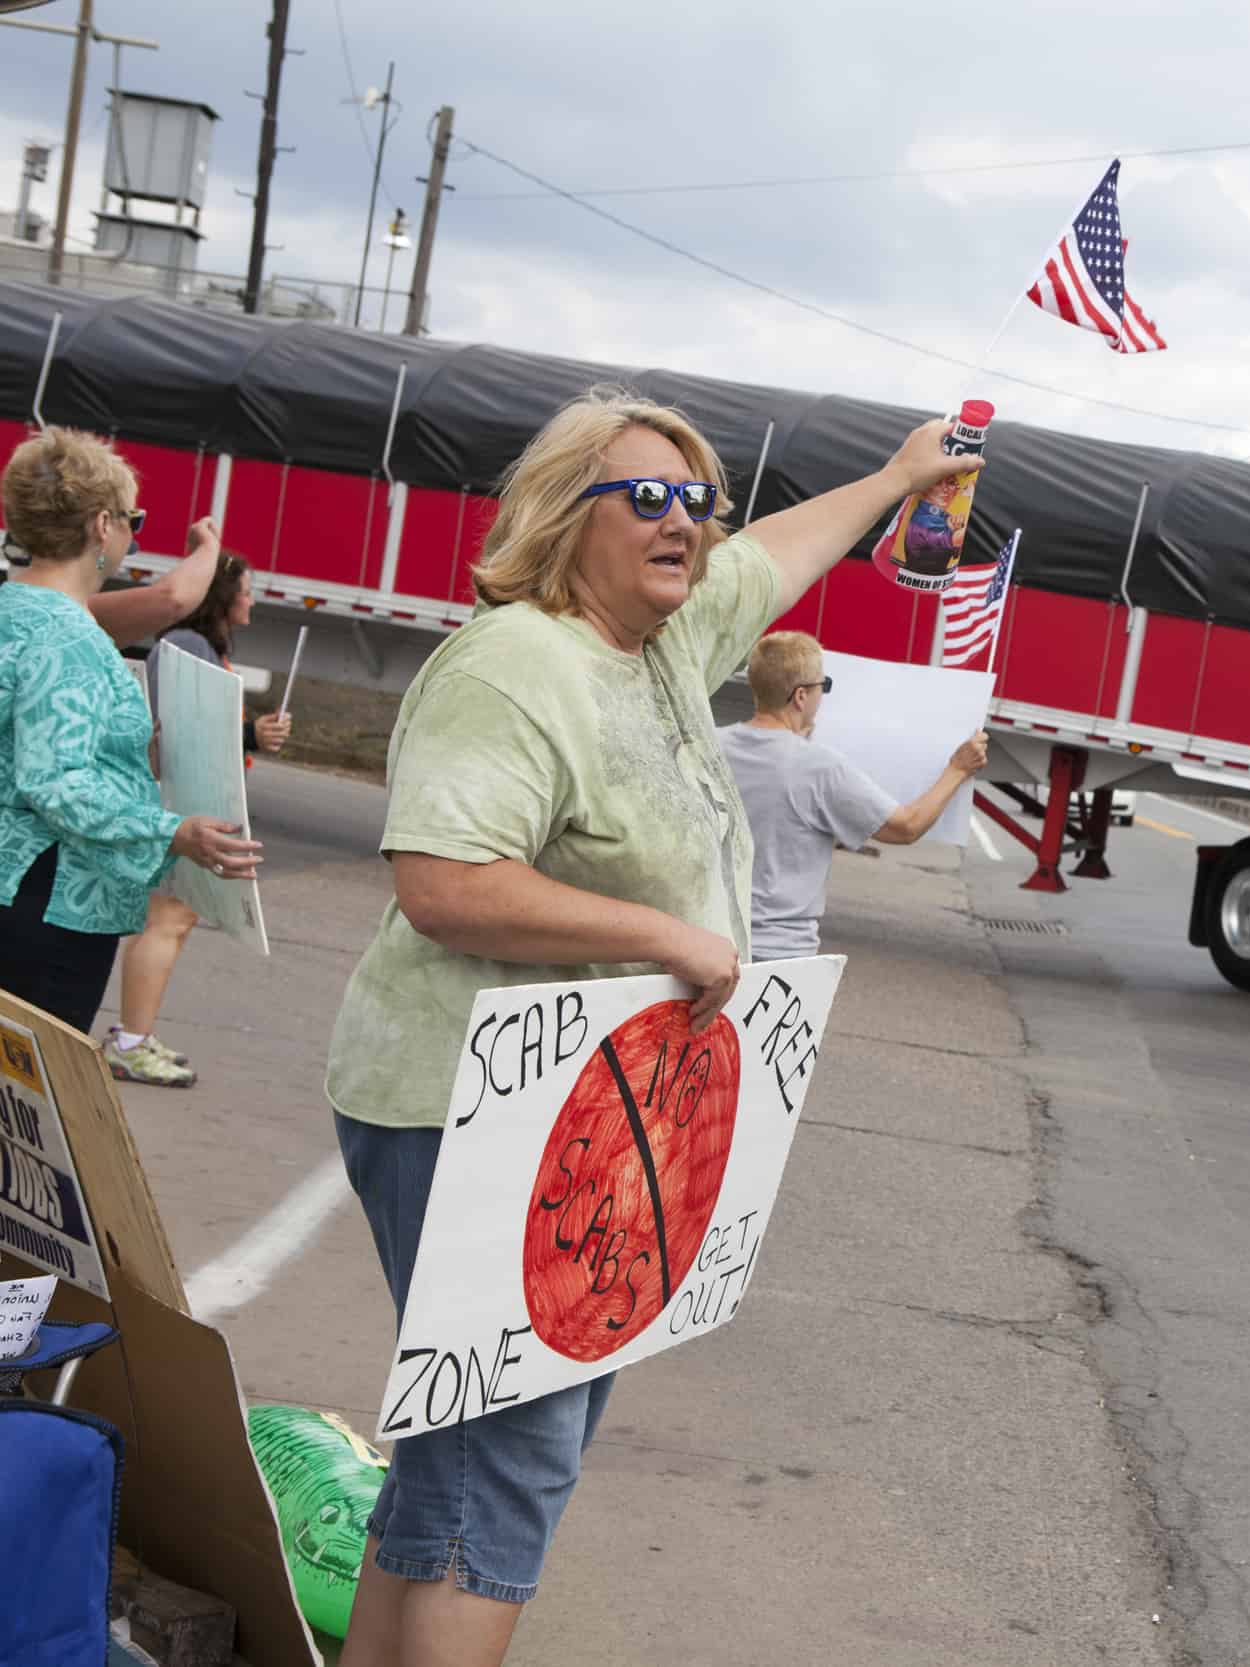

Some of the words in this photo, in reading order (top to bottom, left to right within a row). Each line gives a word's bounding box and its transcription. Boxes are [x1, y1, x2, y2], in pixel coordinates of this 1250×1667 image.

[896, 573, 932, 589] WOMEN
[456, 991, 588, 1128] SCAB
[644, 1039, 711, 1128] NO
[743, 974, 818, 1114] FREE
[6, 1084, 44, 1152] for
[9, 1142, 63, 1229] JOBS
[0, 1212, 76, 1279] ommunity
[541, 1138, 650, 1331] SCABS
[698, 1211, 758, 1272] GET
[670, 1235, 760, 1335] OUT!
[382, 1325, 532, 1433] ZONE
